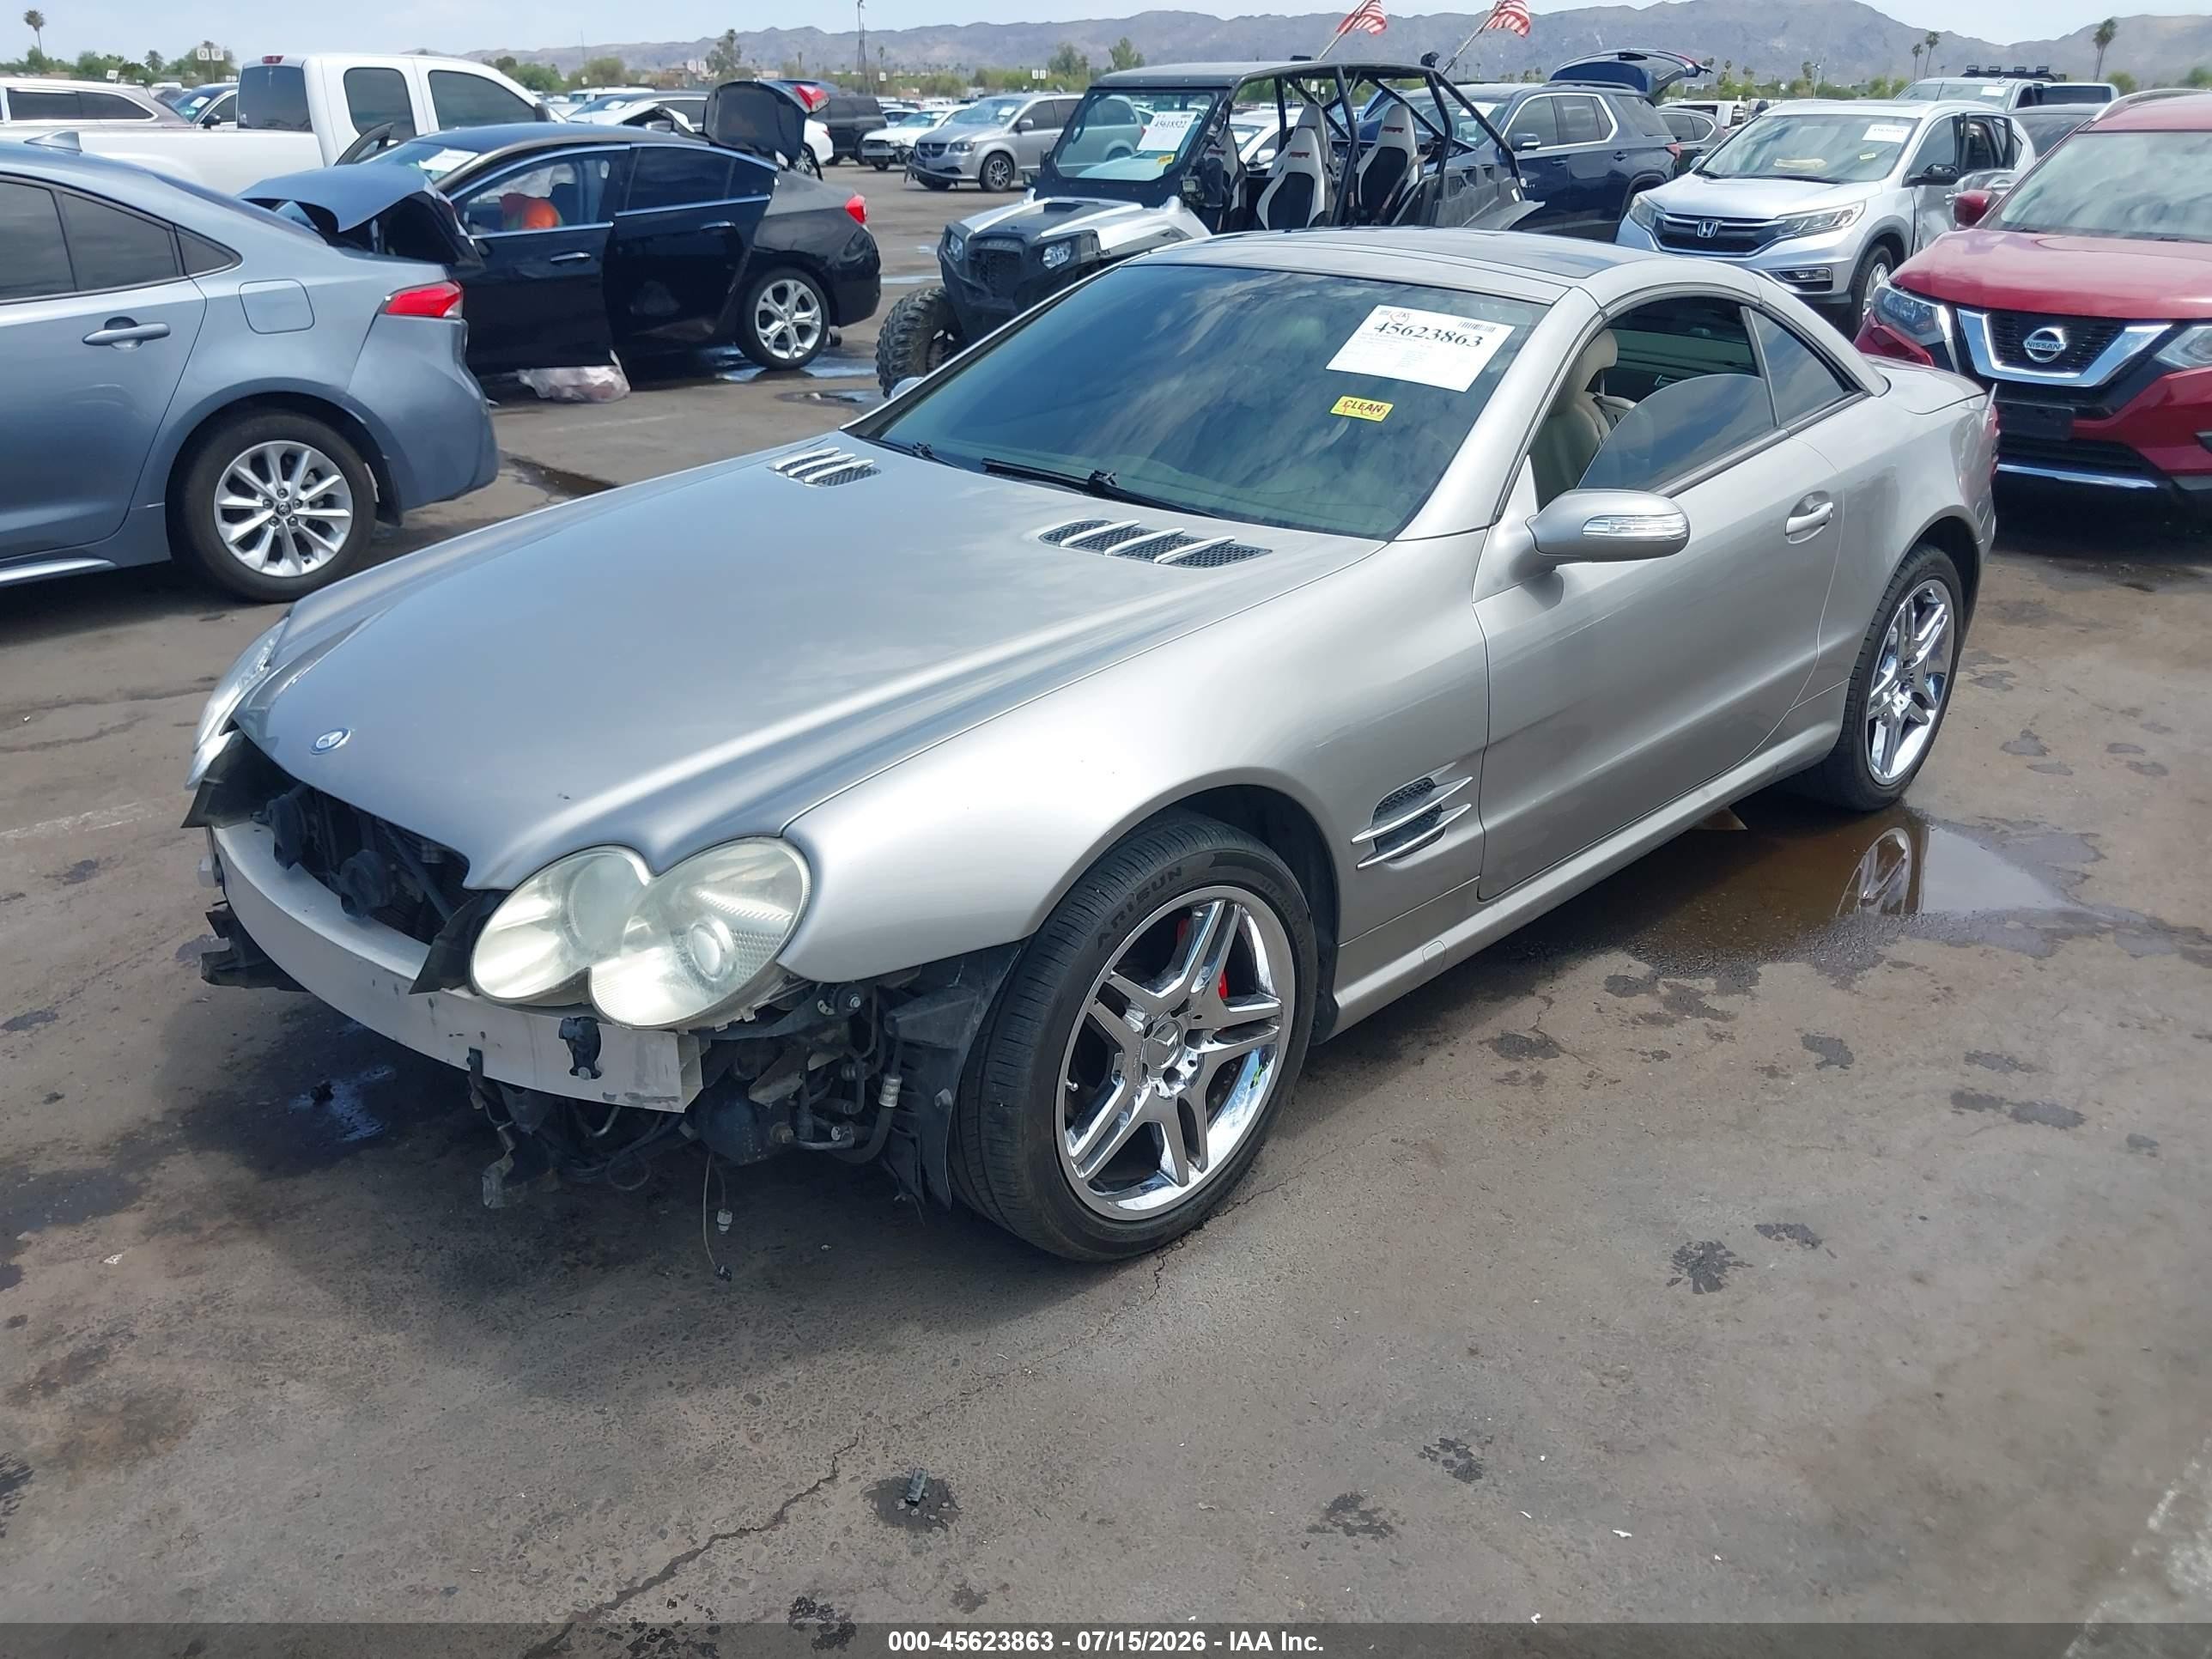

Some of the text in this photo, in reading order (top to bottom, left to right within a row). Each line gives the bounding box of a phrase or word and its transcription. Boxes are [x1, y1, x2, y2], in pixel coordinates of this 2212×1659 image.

[1373, 321, 1484, 348] 45623863
[2027, 341, 2061, 350] NISSAN
[1342, 399, 1385, 413] CLEAN
[1097, 866, 1183, 950] ARISUN
